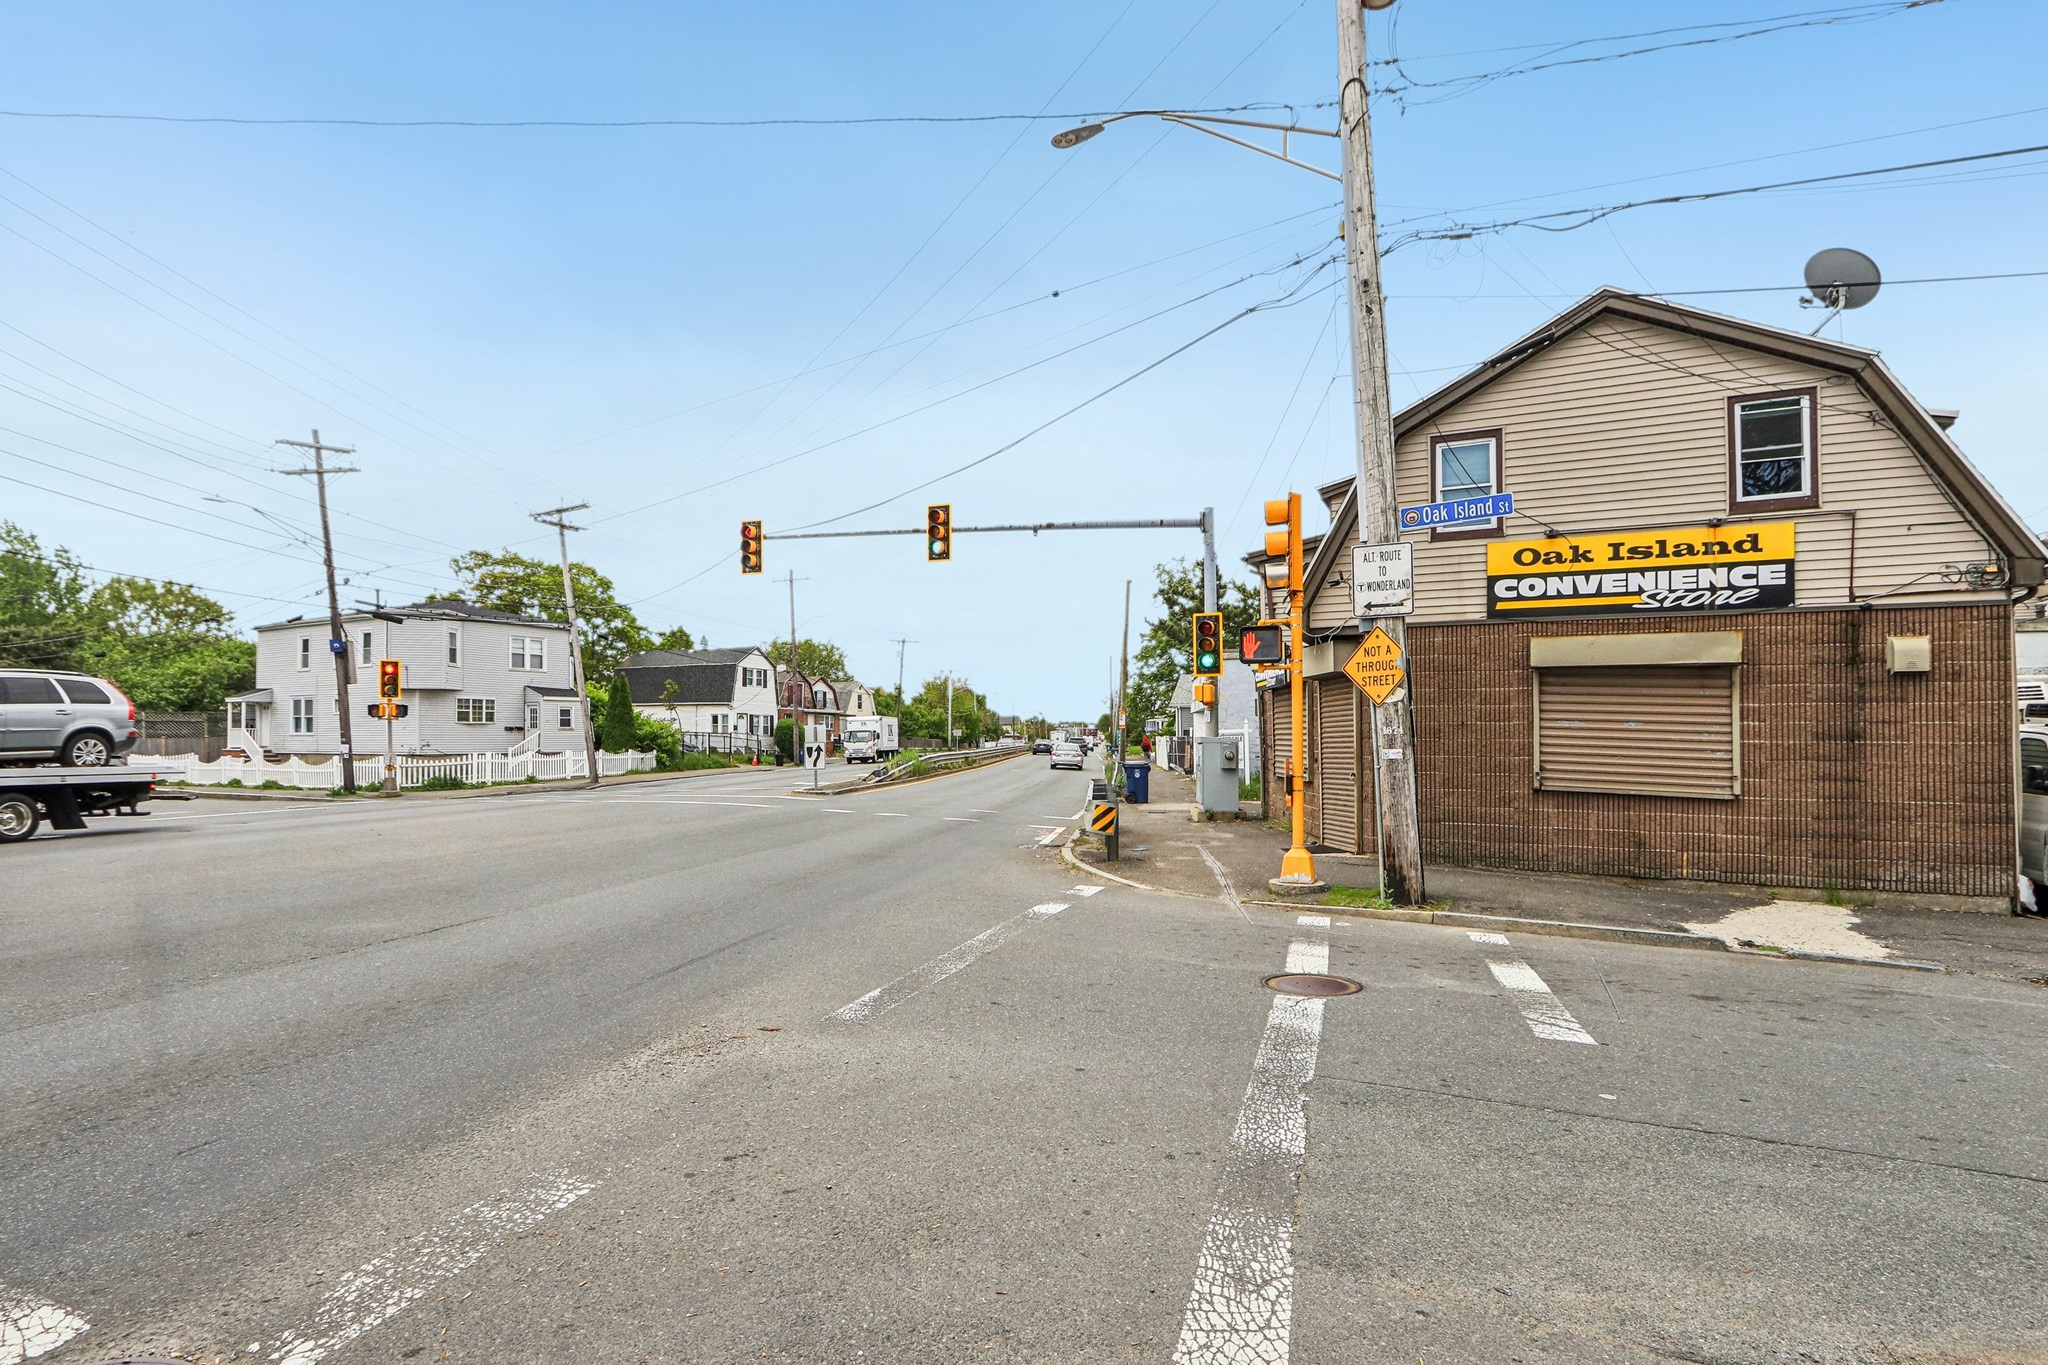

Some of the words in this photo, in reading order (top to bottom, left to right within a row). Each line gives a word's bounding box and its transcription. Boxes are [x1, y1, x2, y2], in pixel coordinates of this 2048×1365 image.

[1423, 505, 1448, 523] Oak
[1454, 498, 1493, 519] Island
[1499, 501, 1509, 513] St
[1380, 550, 1402, 562] ROUTE
[1513, 545, 1594, 567] Oak
[1607, 533, 1763, 561] Island
[1378, 566, 1387, 577] TO
[1367, 578, 1411, 592] WONDERLAND
[1494, 563, 1786, 599] CONVENIENCE
[1632, 588, 1760, 609] Store
[1363, 645, 1381, 657] NOT
[1385, 645, 1392, 655] A
[1361, 674, 1396, 687] STREET
